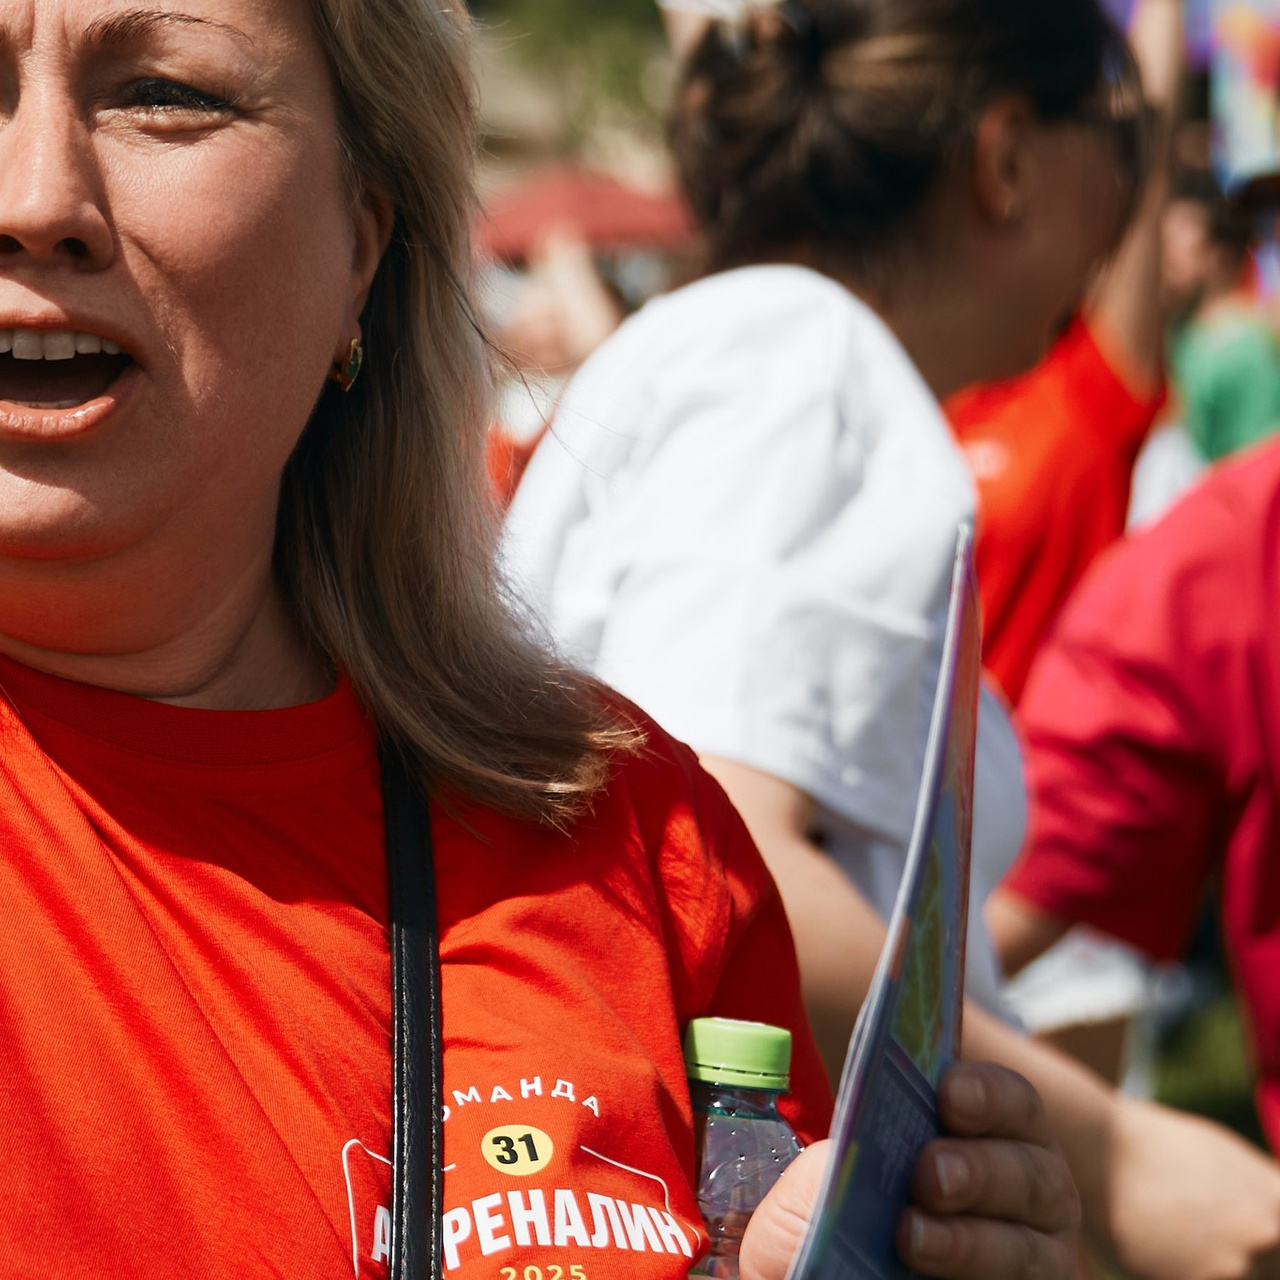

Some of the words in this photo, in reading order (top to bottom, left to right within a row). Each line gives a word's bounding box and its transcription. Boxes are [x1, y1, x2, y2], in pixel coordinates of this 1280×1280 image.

[442, 1076, 600, 1121] МАНДА
[492, 1133, 539, 1165] 31
[371, 1189, 693, 1271] АРЕНАЛИН
